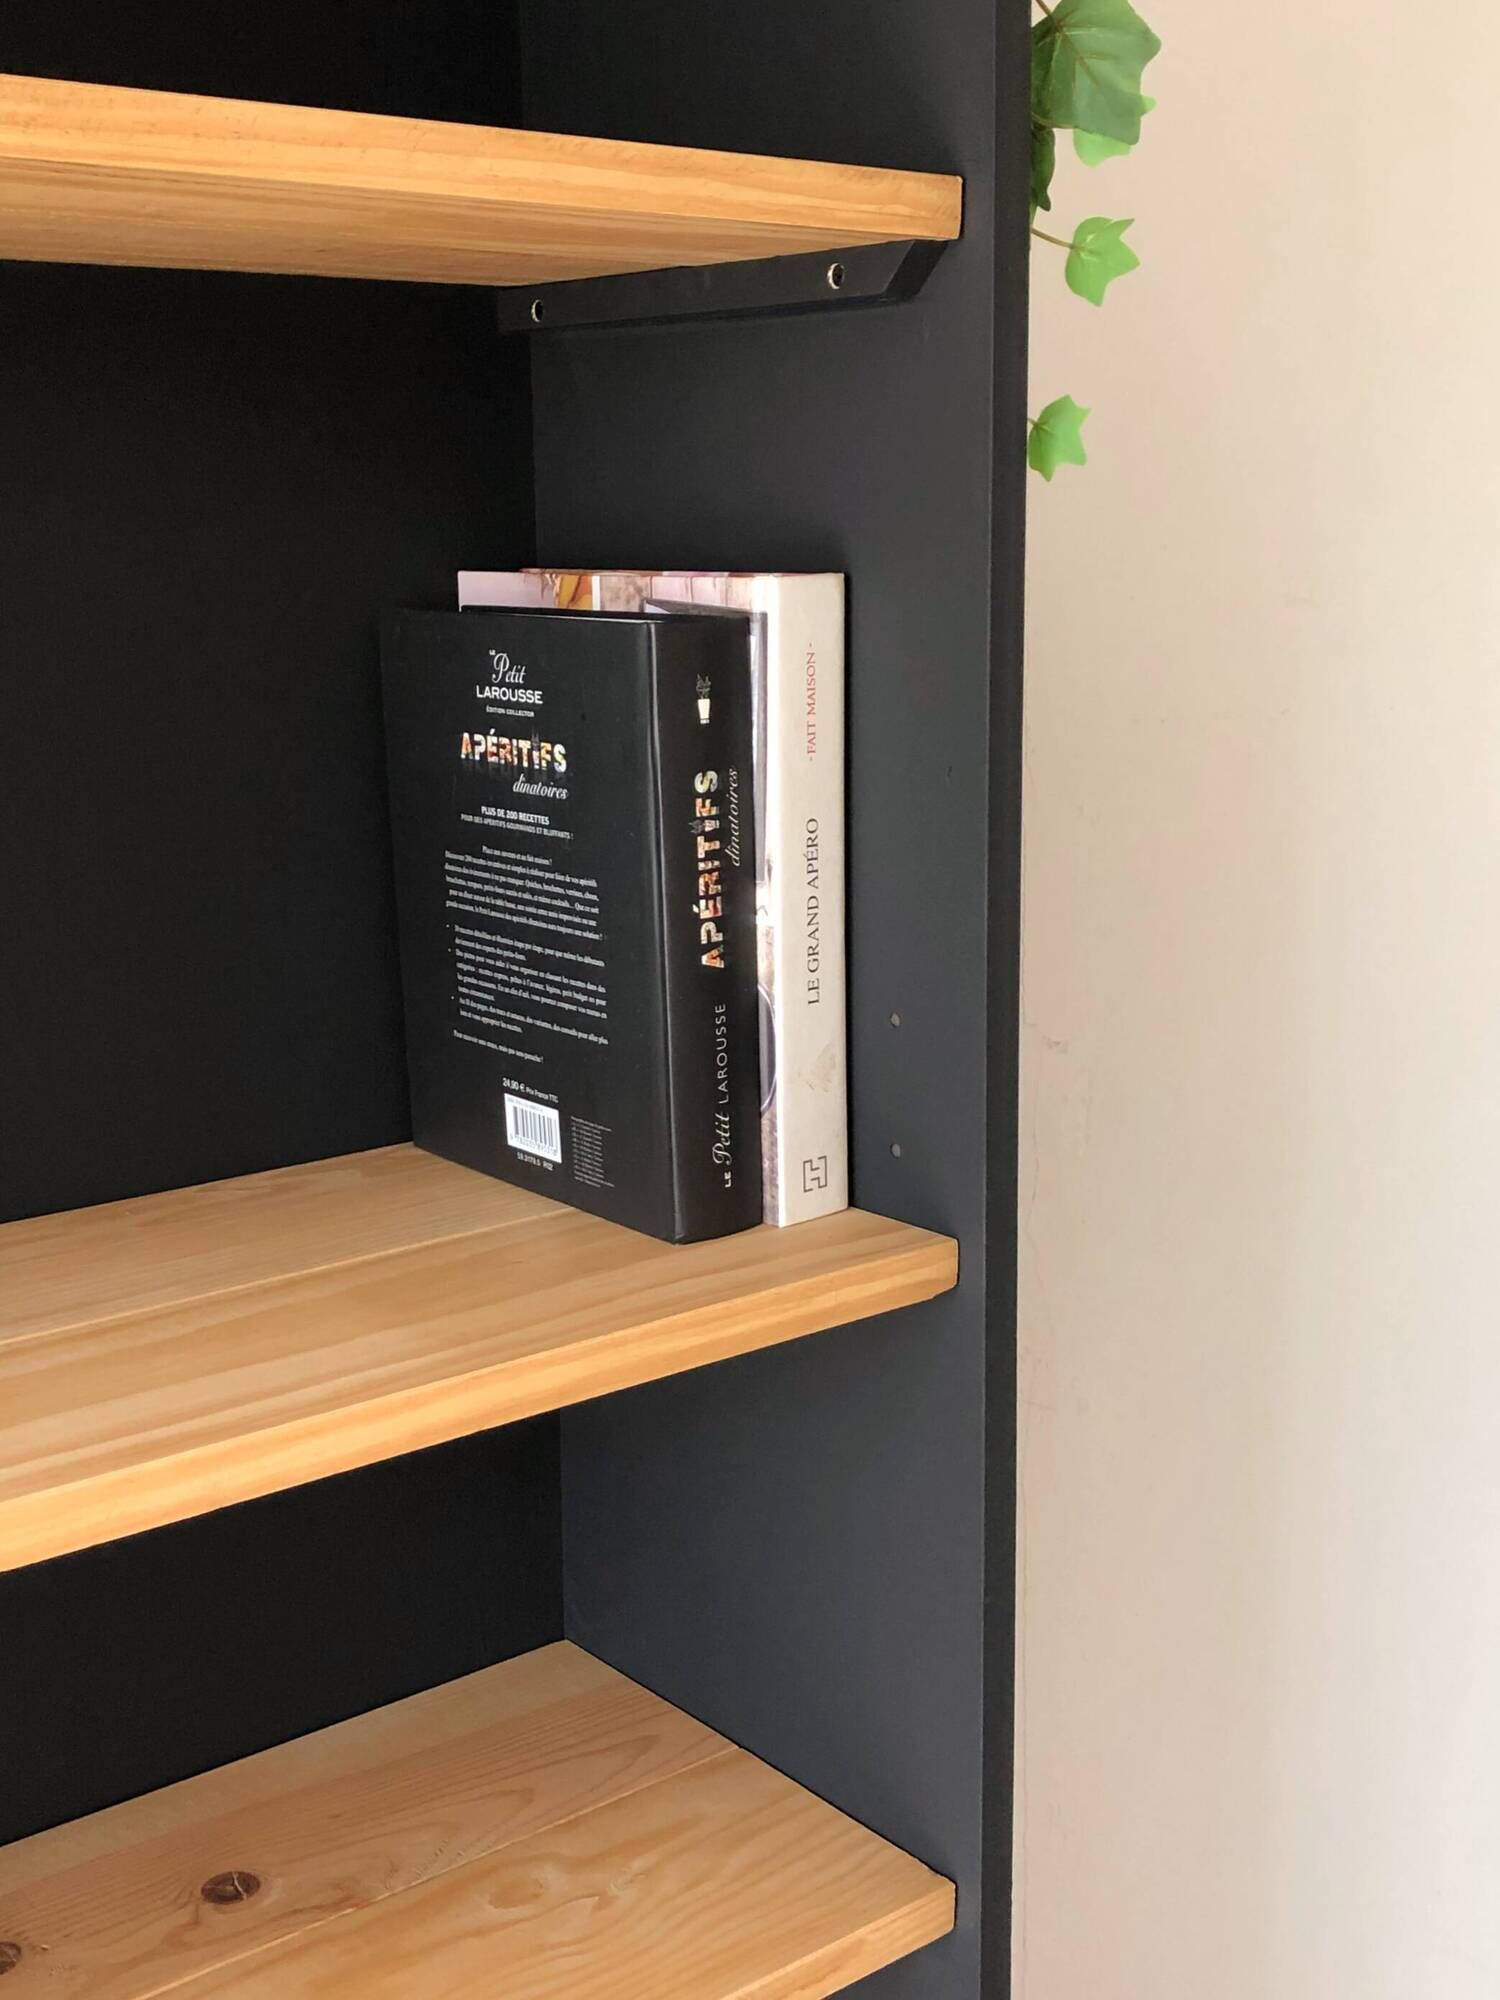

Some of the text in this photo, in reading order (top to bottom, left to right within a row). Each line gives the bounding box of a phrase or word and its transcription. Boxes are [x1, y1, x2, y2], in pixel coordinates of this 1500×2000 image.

[491, 653, 527, 684] Petit
[806, 652, 816, 716] MAISON
[476, 684, 543, 705] LAROUSSE
[460, 728, 567, 773] APÉRITIFS
[806, 721, 816, 754] FAIT
[481, 805, 496, 817] PLUS
[518, 812, 550, 826] RECETTES
[690, 769, 725, 969] APÉRITIFS
[802, 817, 820, 1005] LE GRAND APÉRO
[712, 1003, 733, 1188] LE Petit LAROUSSE
